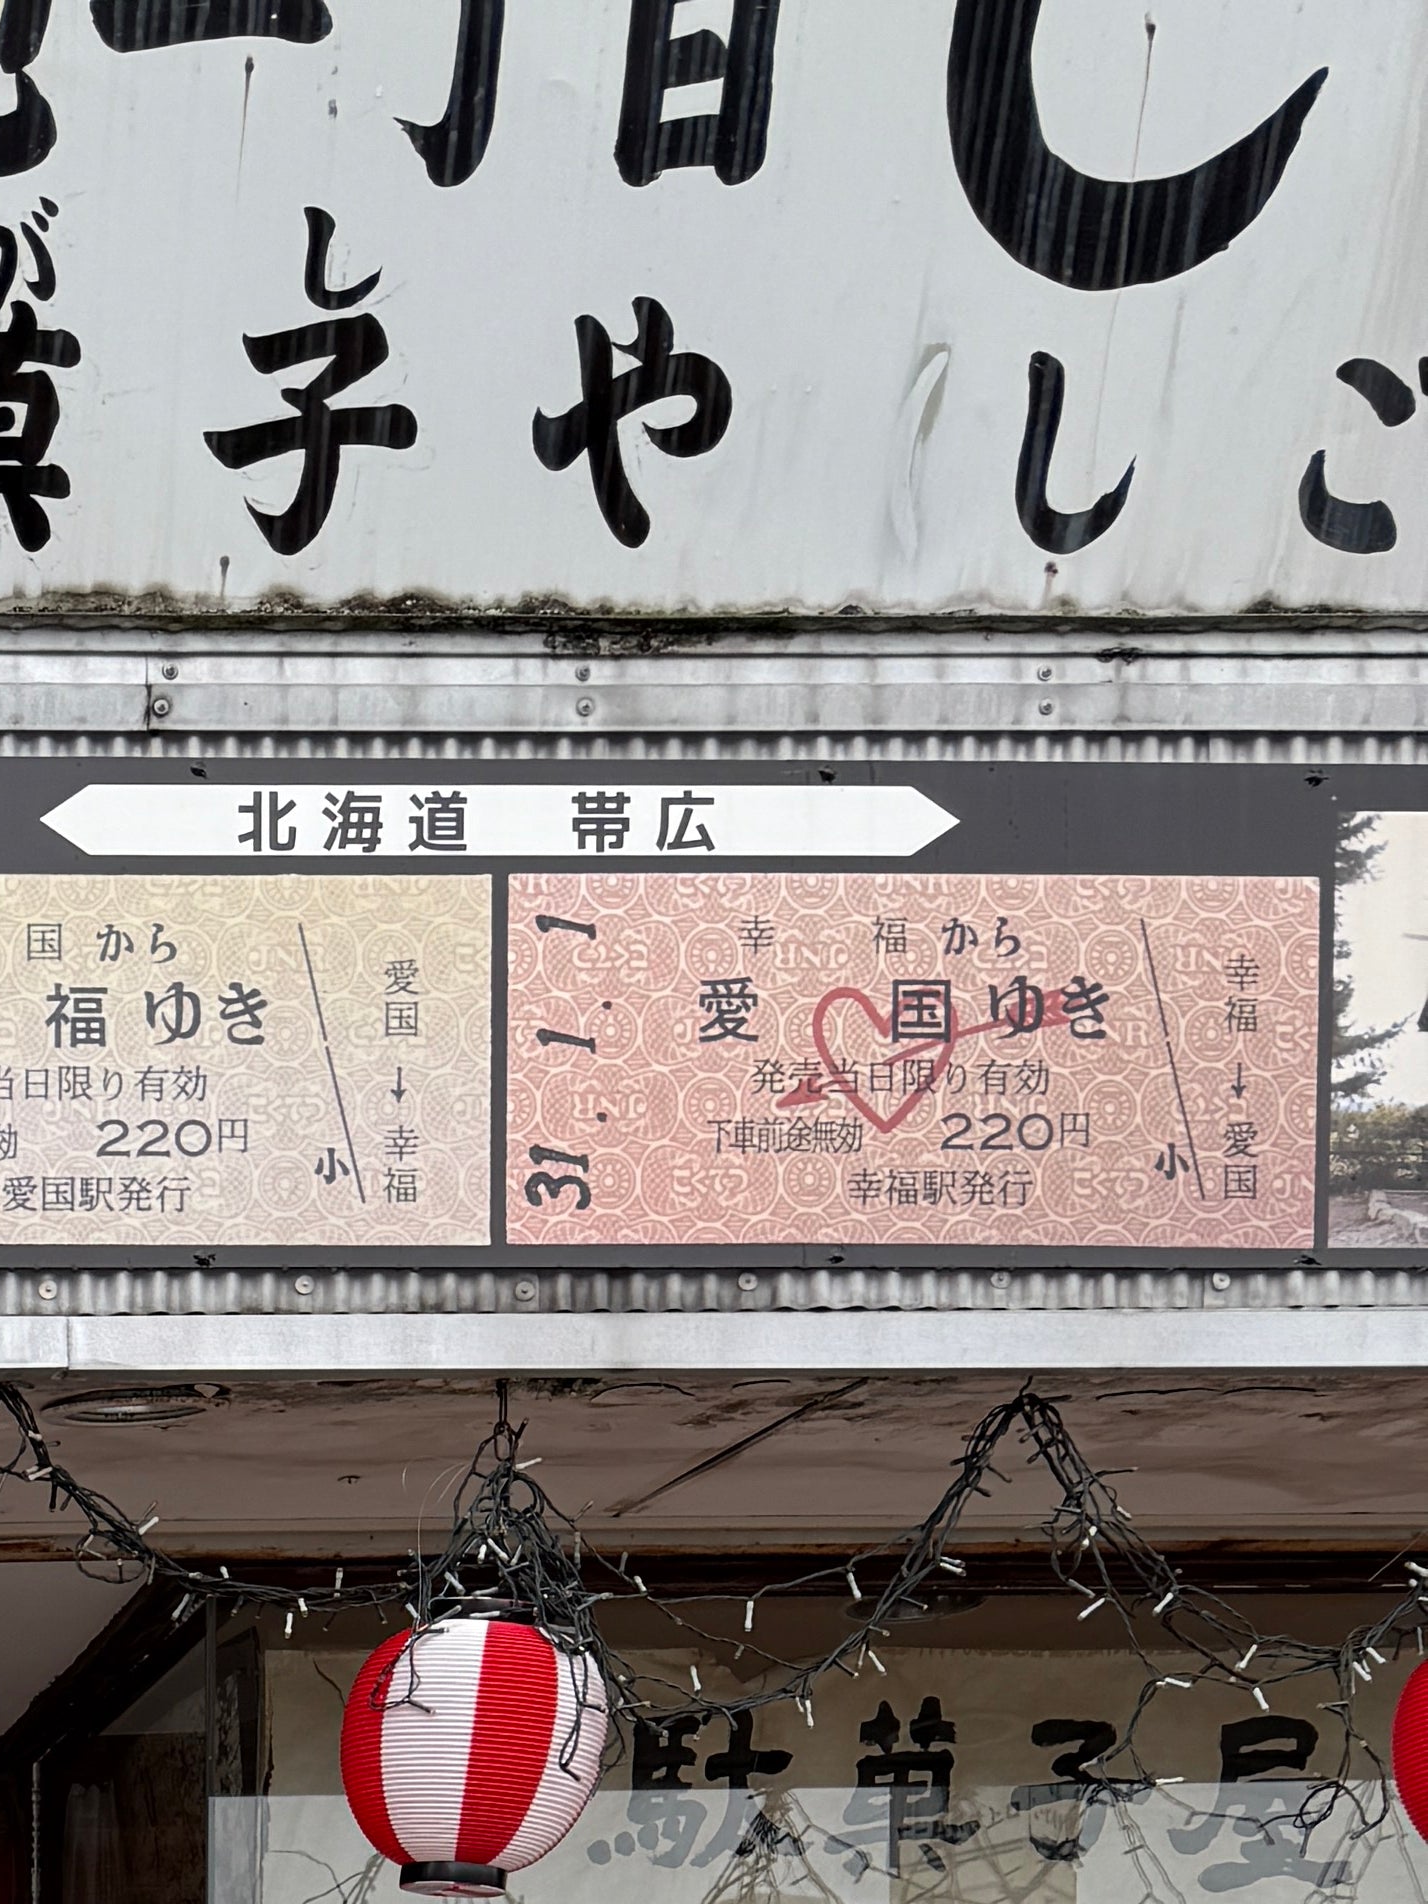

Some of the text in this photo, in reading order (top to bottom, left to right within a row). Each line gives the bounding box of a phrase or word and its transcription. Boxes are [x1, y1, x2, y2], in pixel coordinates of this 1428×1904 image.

[238, 790, 716, 854] 北海道 帯広
[697, 976, 1111, 1042] 愛国ゆき
[382, 958, 421, 1204] 愛国 幸福
[750, 1058, 1051, 1096] 発売当日限り有効
[1222, 954, 1260, 1201] 幸福 愛国
[95, 1116, 251, 1160] 220円
[706, 1110, 1092, 1155] 下車前途無効 220円
[2, 1175, 192, 1214] 愛国駅発行
[847, 1167, 1035, 1208] 幸福駅発行
